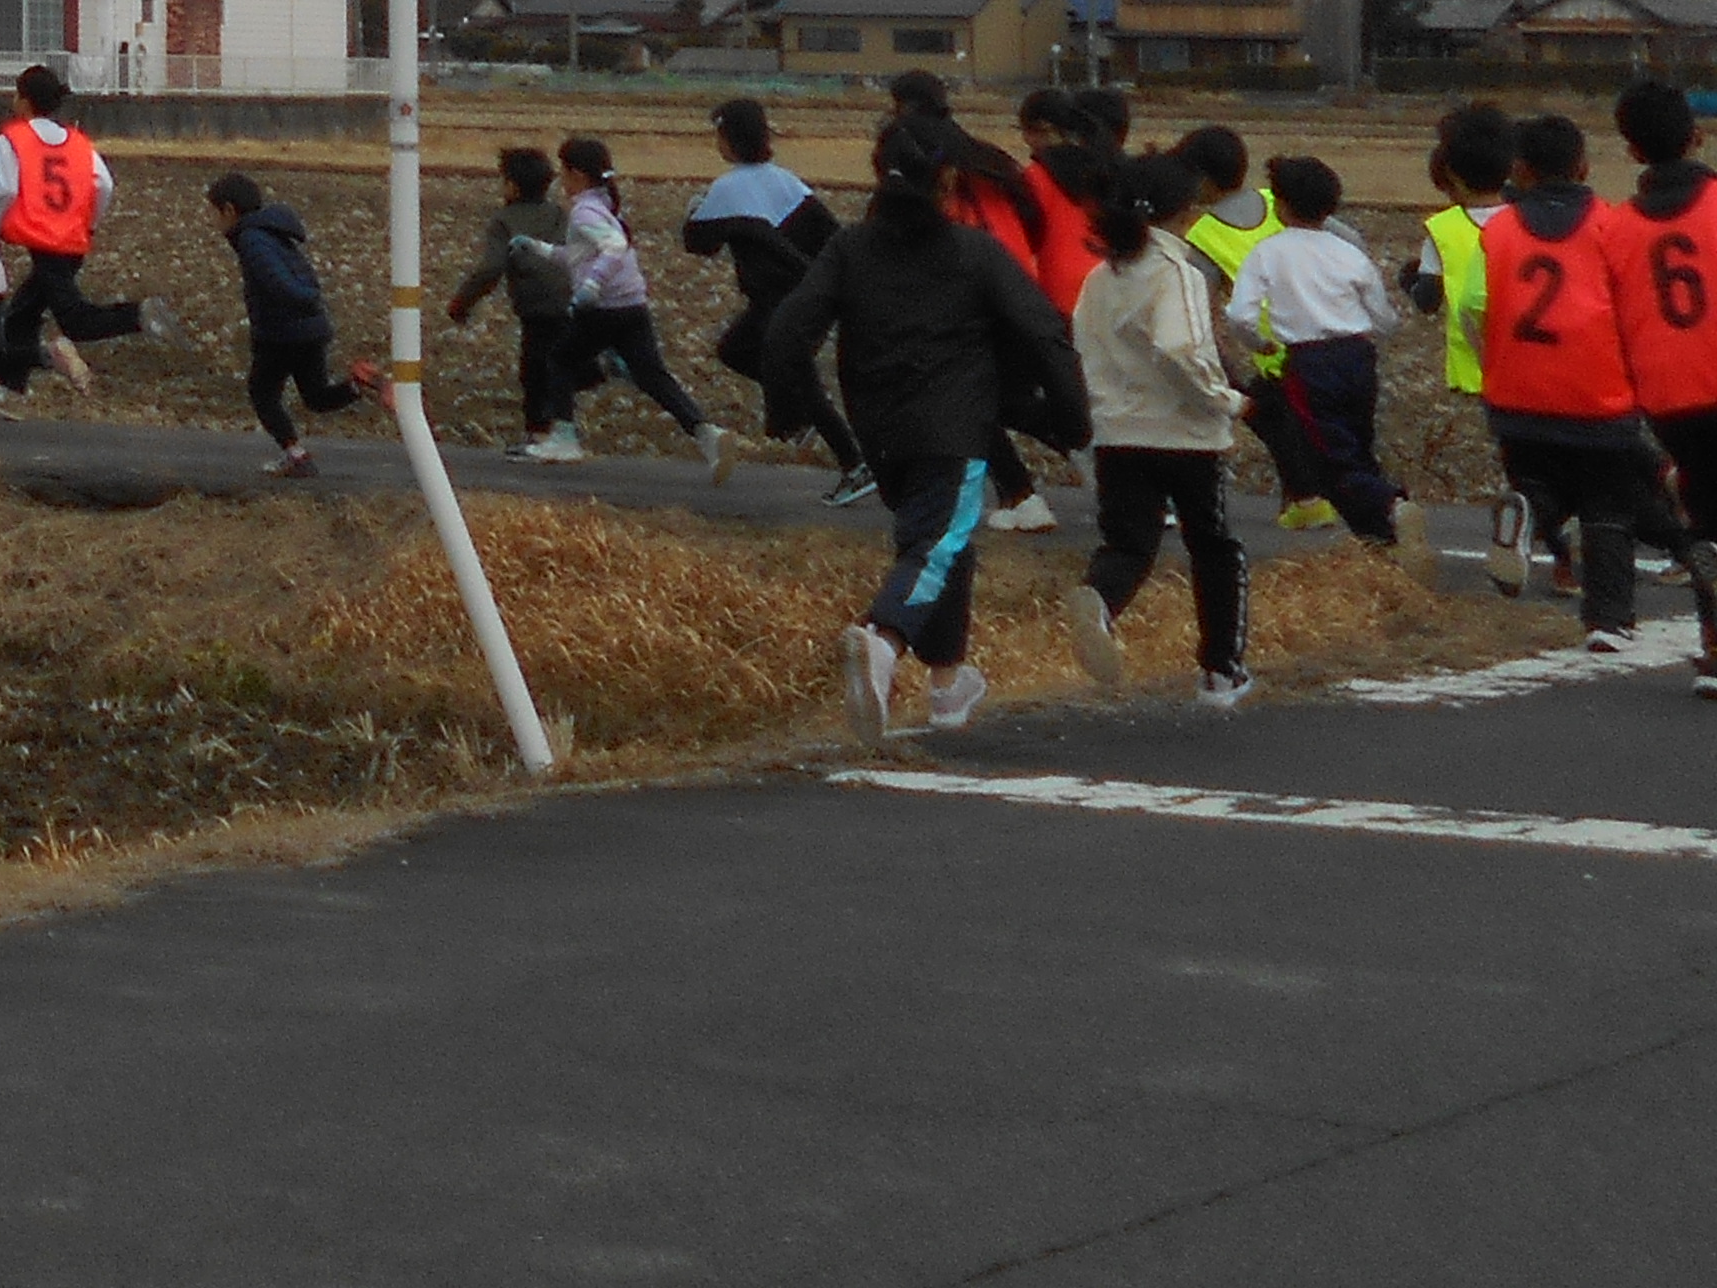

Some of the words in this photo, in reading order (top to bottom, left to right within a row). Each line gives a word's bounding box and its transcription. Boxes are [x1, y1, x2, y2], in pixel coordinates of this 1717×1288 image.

[43, 155, 73, 213] 5
[1513, 254, 1563, 344] 2
[1651, 232, 1705, 329] 6
